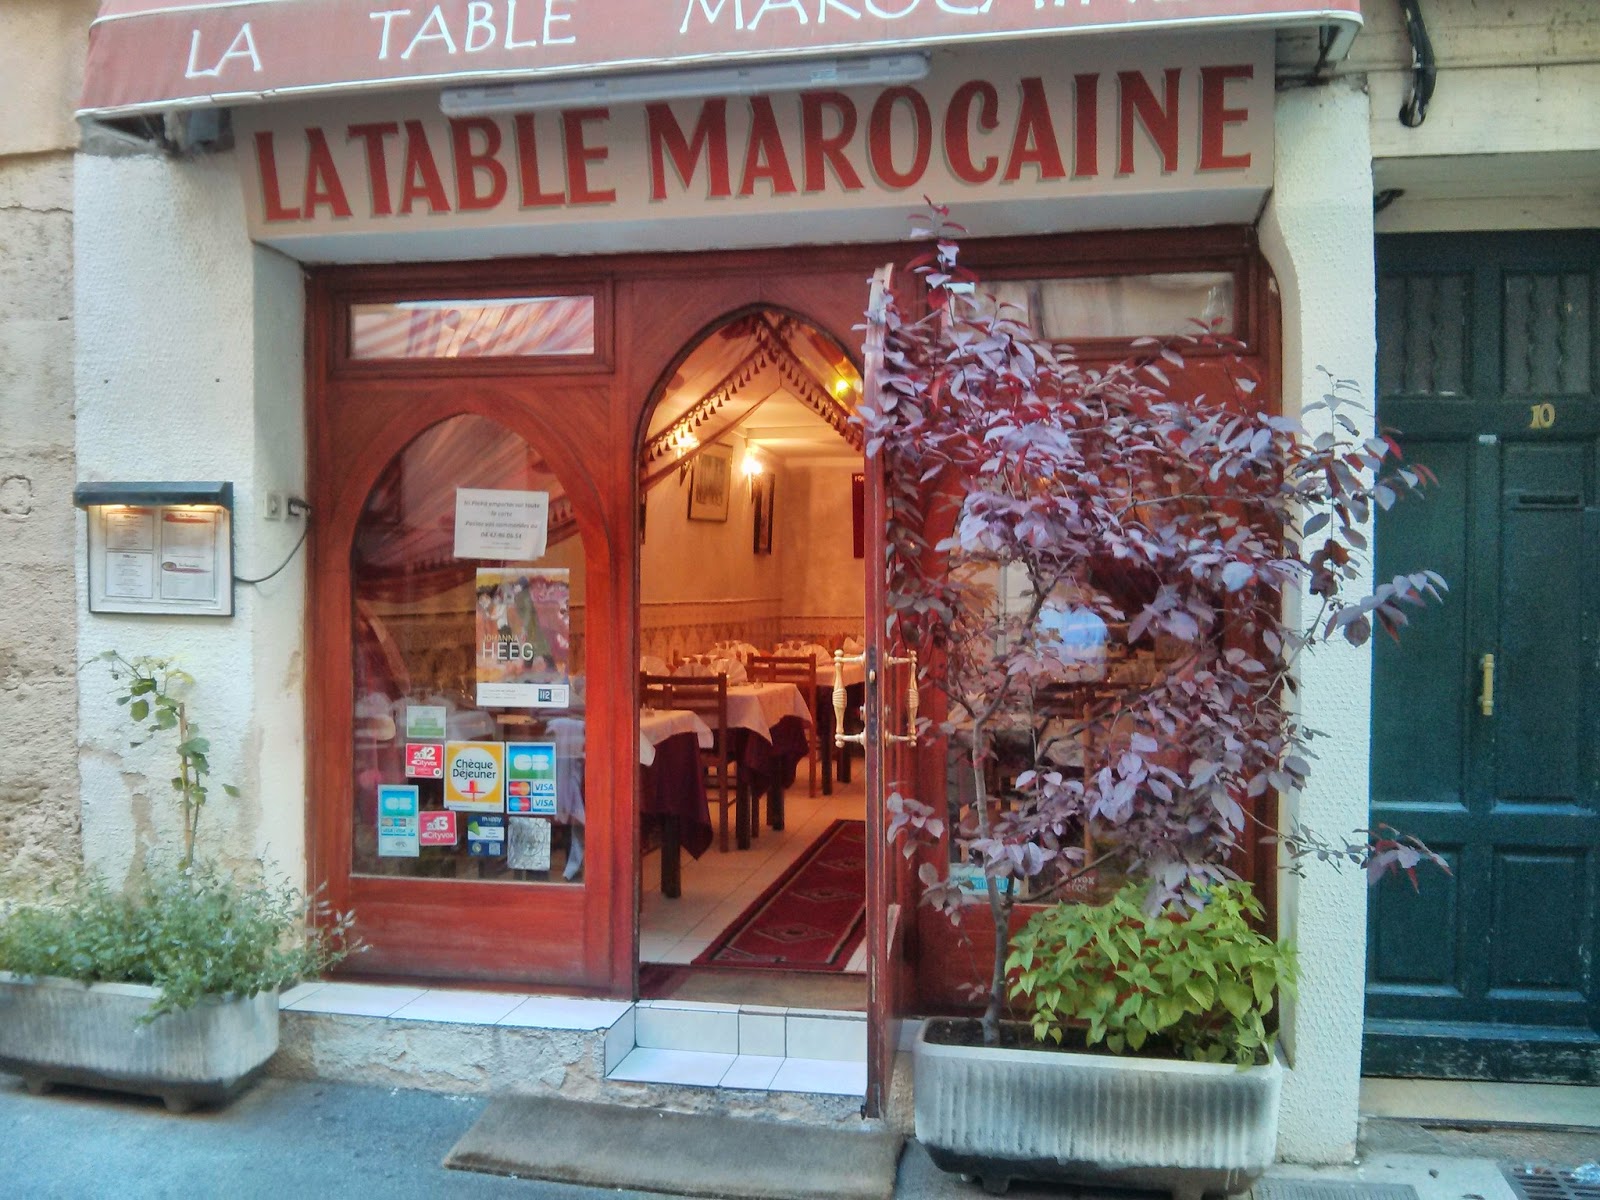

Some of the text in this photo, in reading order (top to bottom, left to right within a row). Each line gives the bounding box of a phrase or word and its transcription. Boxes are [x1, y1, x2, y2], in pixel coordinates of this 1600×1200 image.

[184, 0, 577, 79] LA TABLE
[254, 64, 1254, 222] LA TABLE MAROCAINE
[1530, 403, 1556, 429] 10
[482, 642, 534, 661] HEEG
[455, 758, 494, 770] Chèque
[534, 783, 554, 791] VISA
[534, 799, 554, 807] VISA
